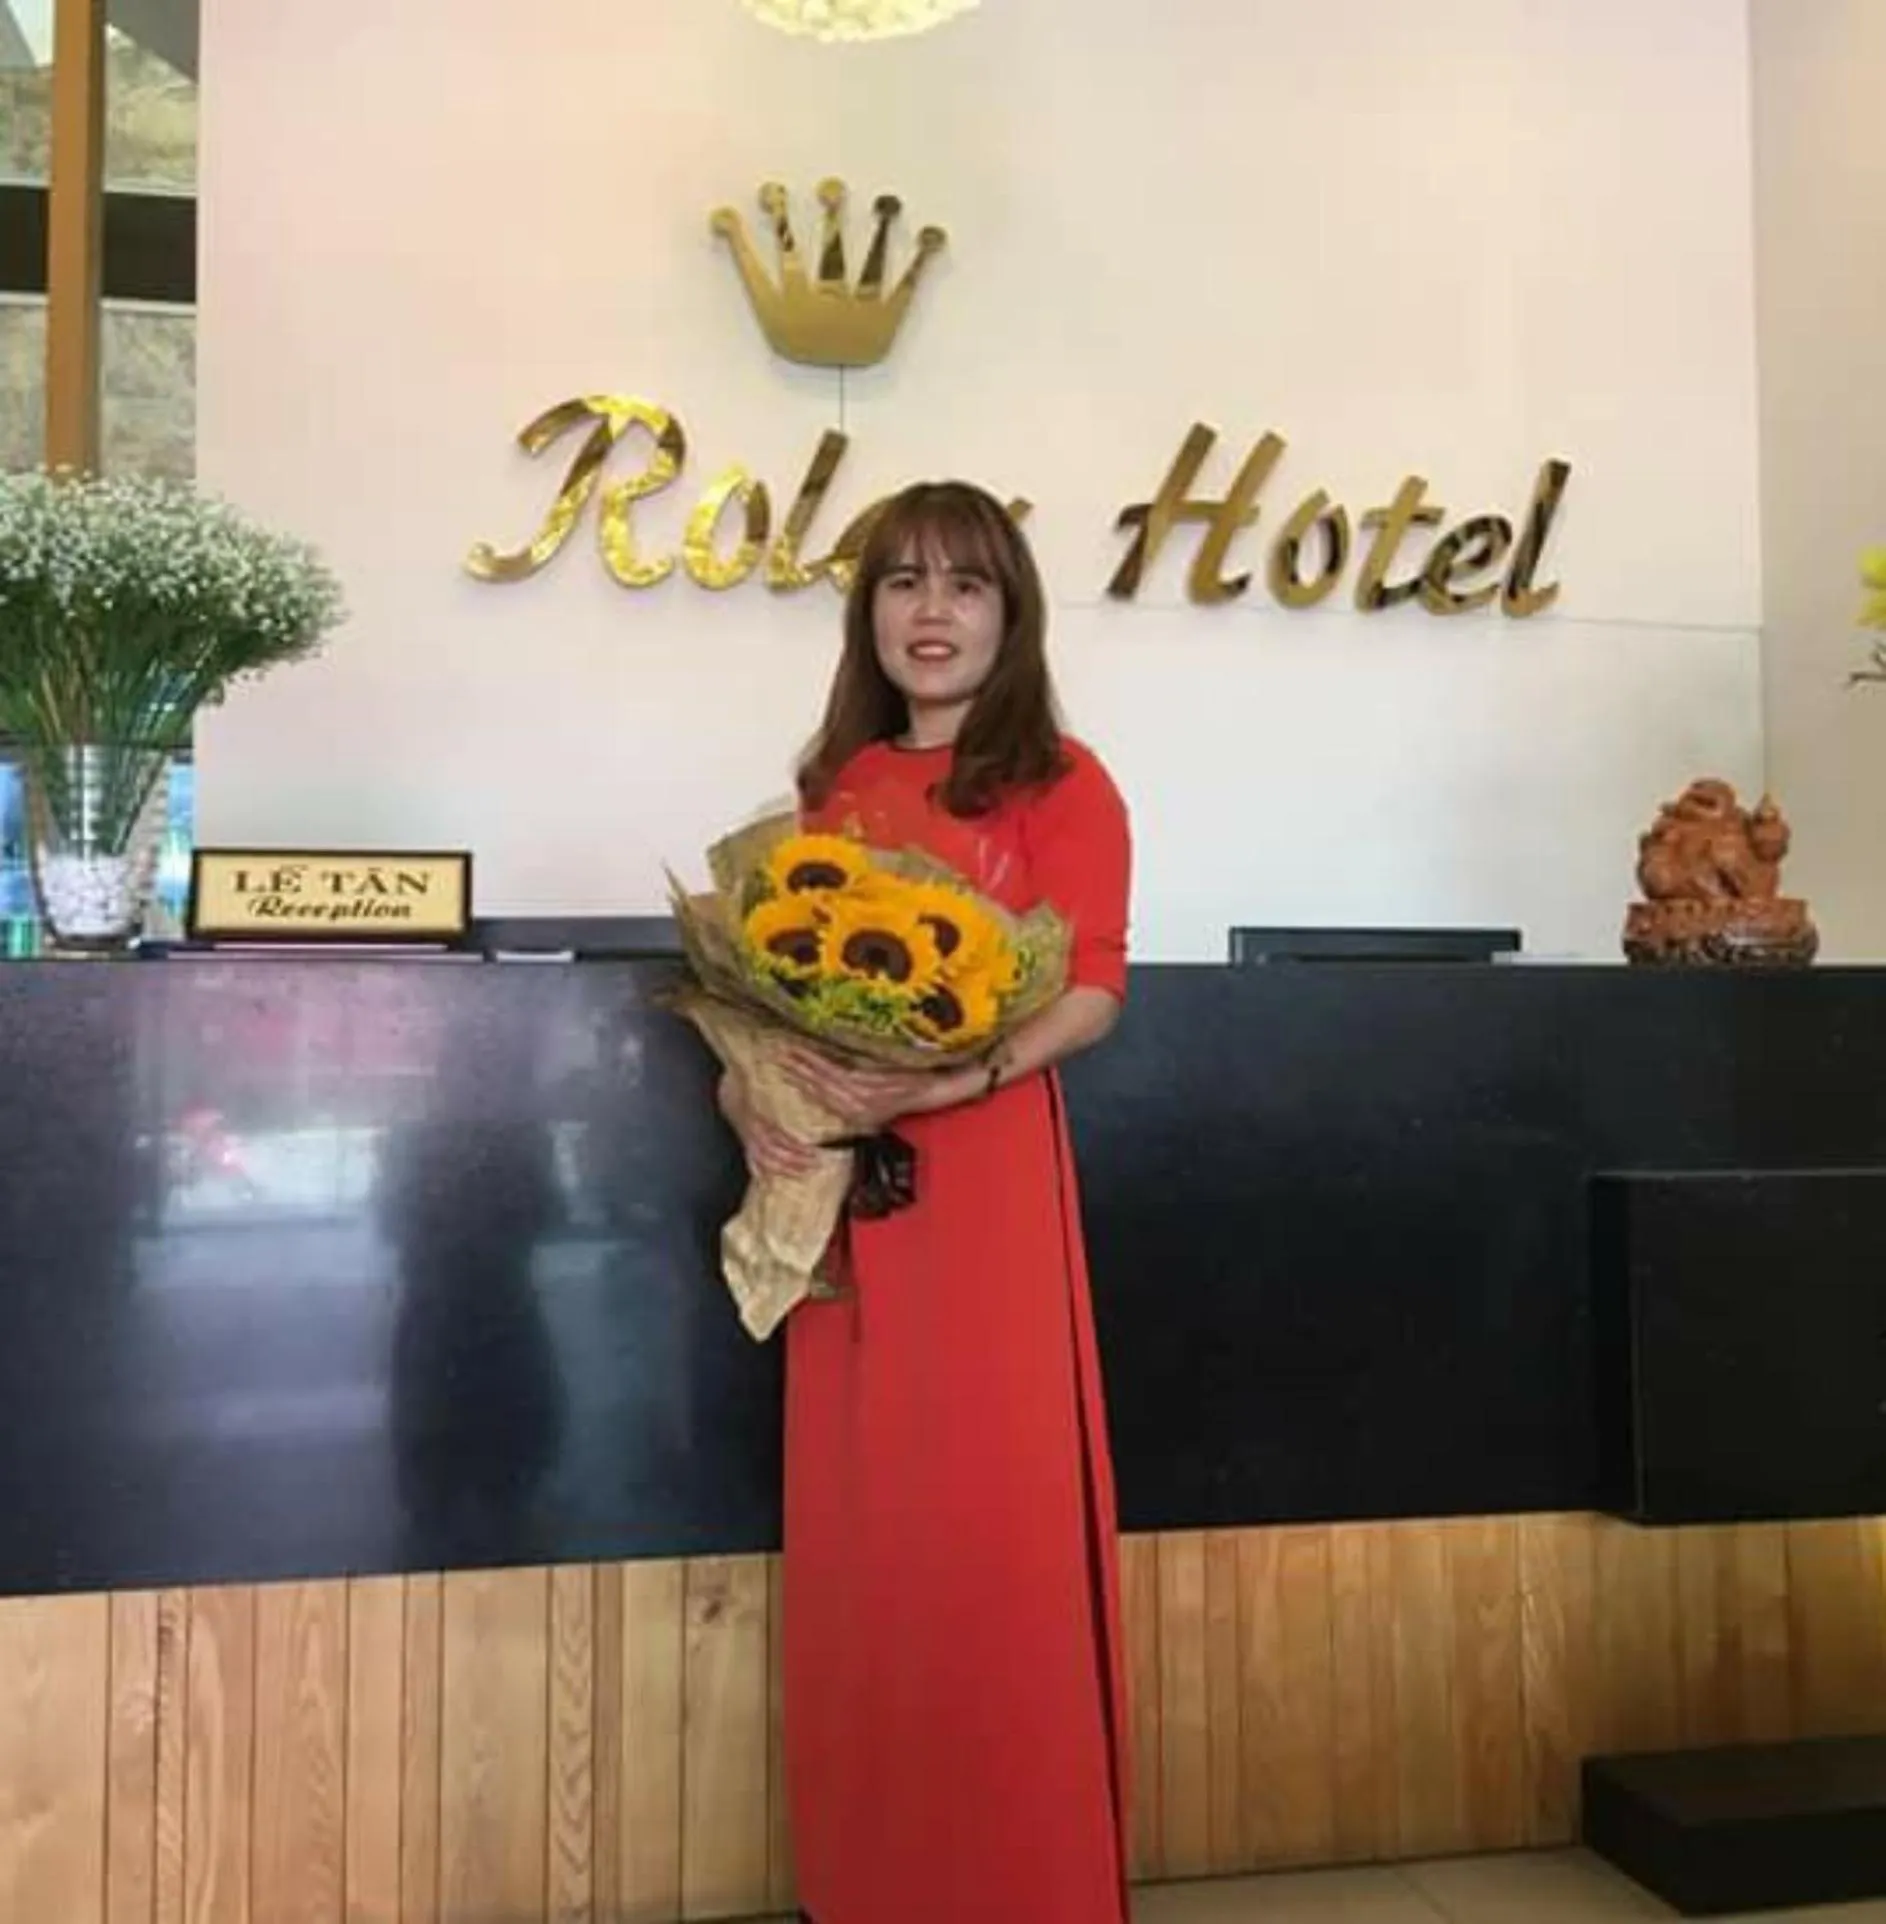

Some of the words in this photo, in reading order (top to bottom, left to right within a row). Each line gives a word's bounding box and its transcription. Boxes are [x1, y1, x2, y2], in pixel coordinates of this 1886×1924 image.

[465, 394, 1033, 594] Rol
[1106, 422, 1571, 618] Hotel
[247, 895, 411, 922] Reception
